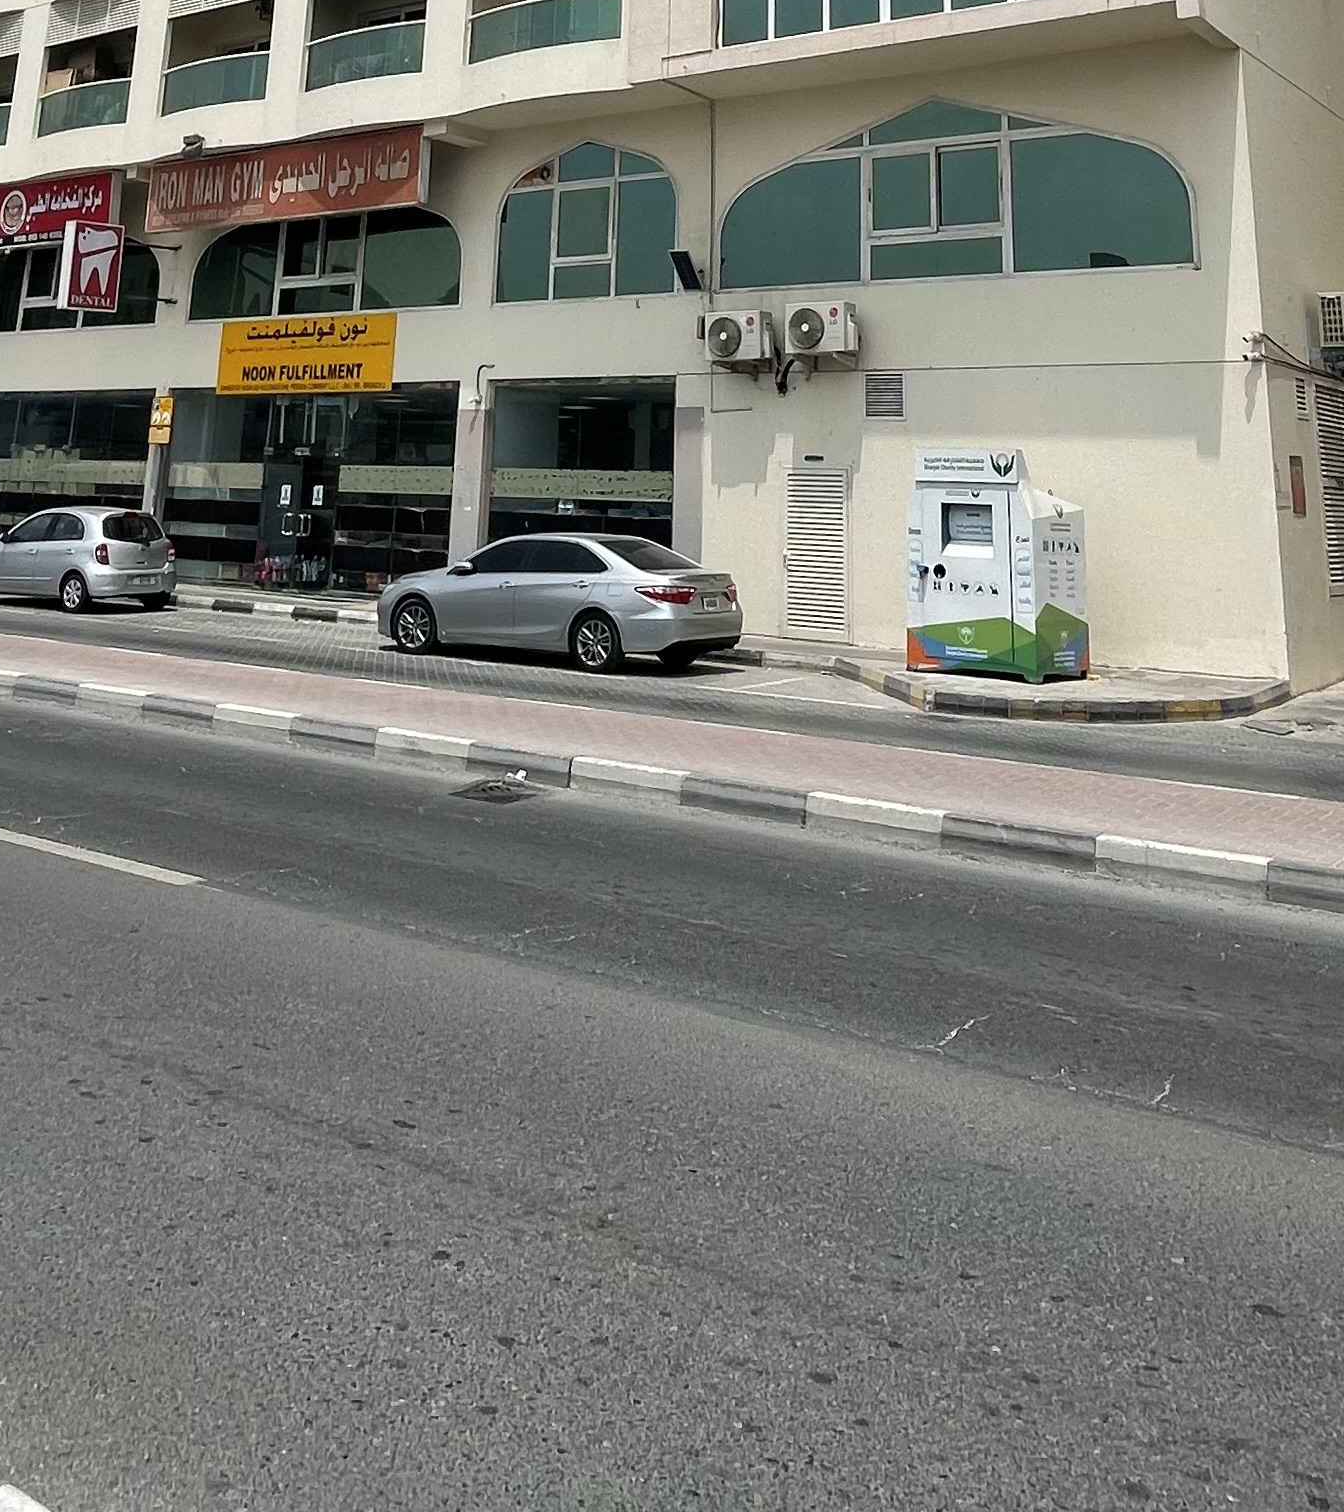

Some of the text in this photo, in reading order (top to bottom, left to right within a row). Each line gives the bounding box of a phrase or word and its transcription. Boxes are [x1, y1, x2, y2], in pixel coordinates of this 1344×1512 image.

[192, 165, 225, 207] MAN
[230, 160, 265, 203] GYM
[70, 294, 114, 308] DENTAL
[246, 317, 368, 344] نون فولفيلمنت
[242, 363, 364, 381] NOON FULFILLMENT
